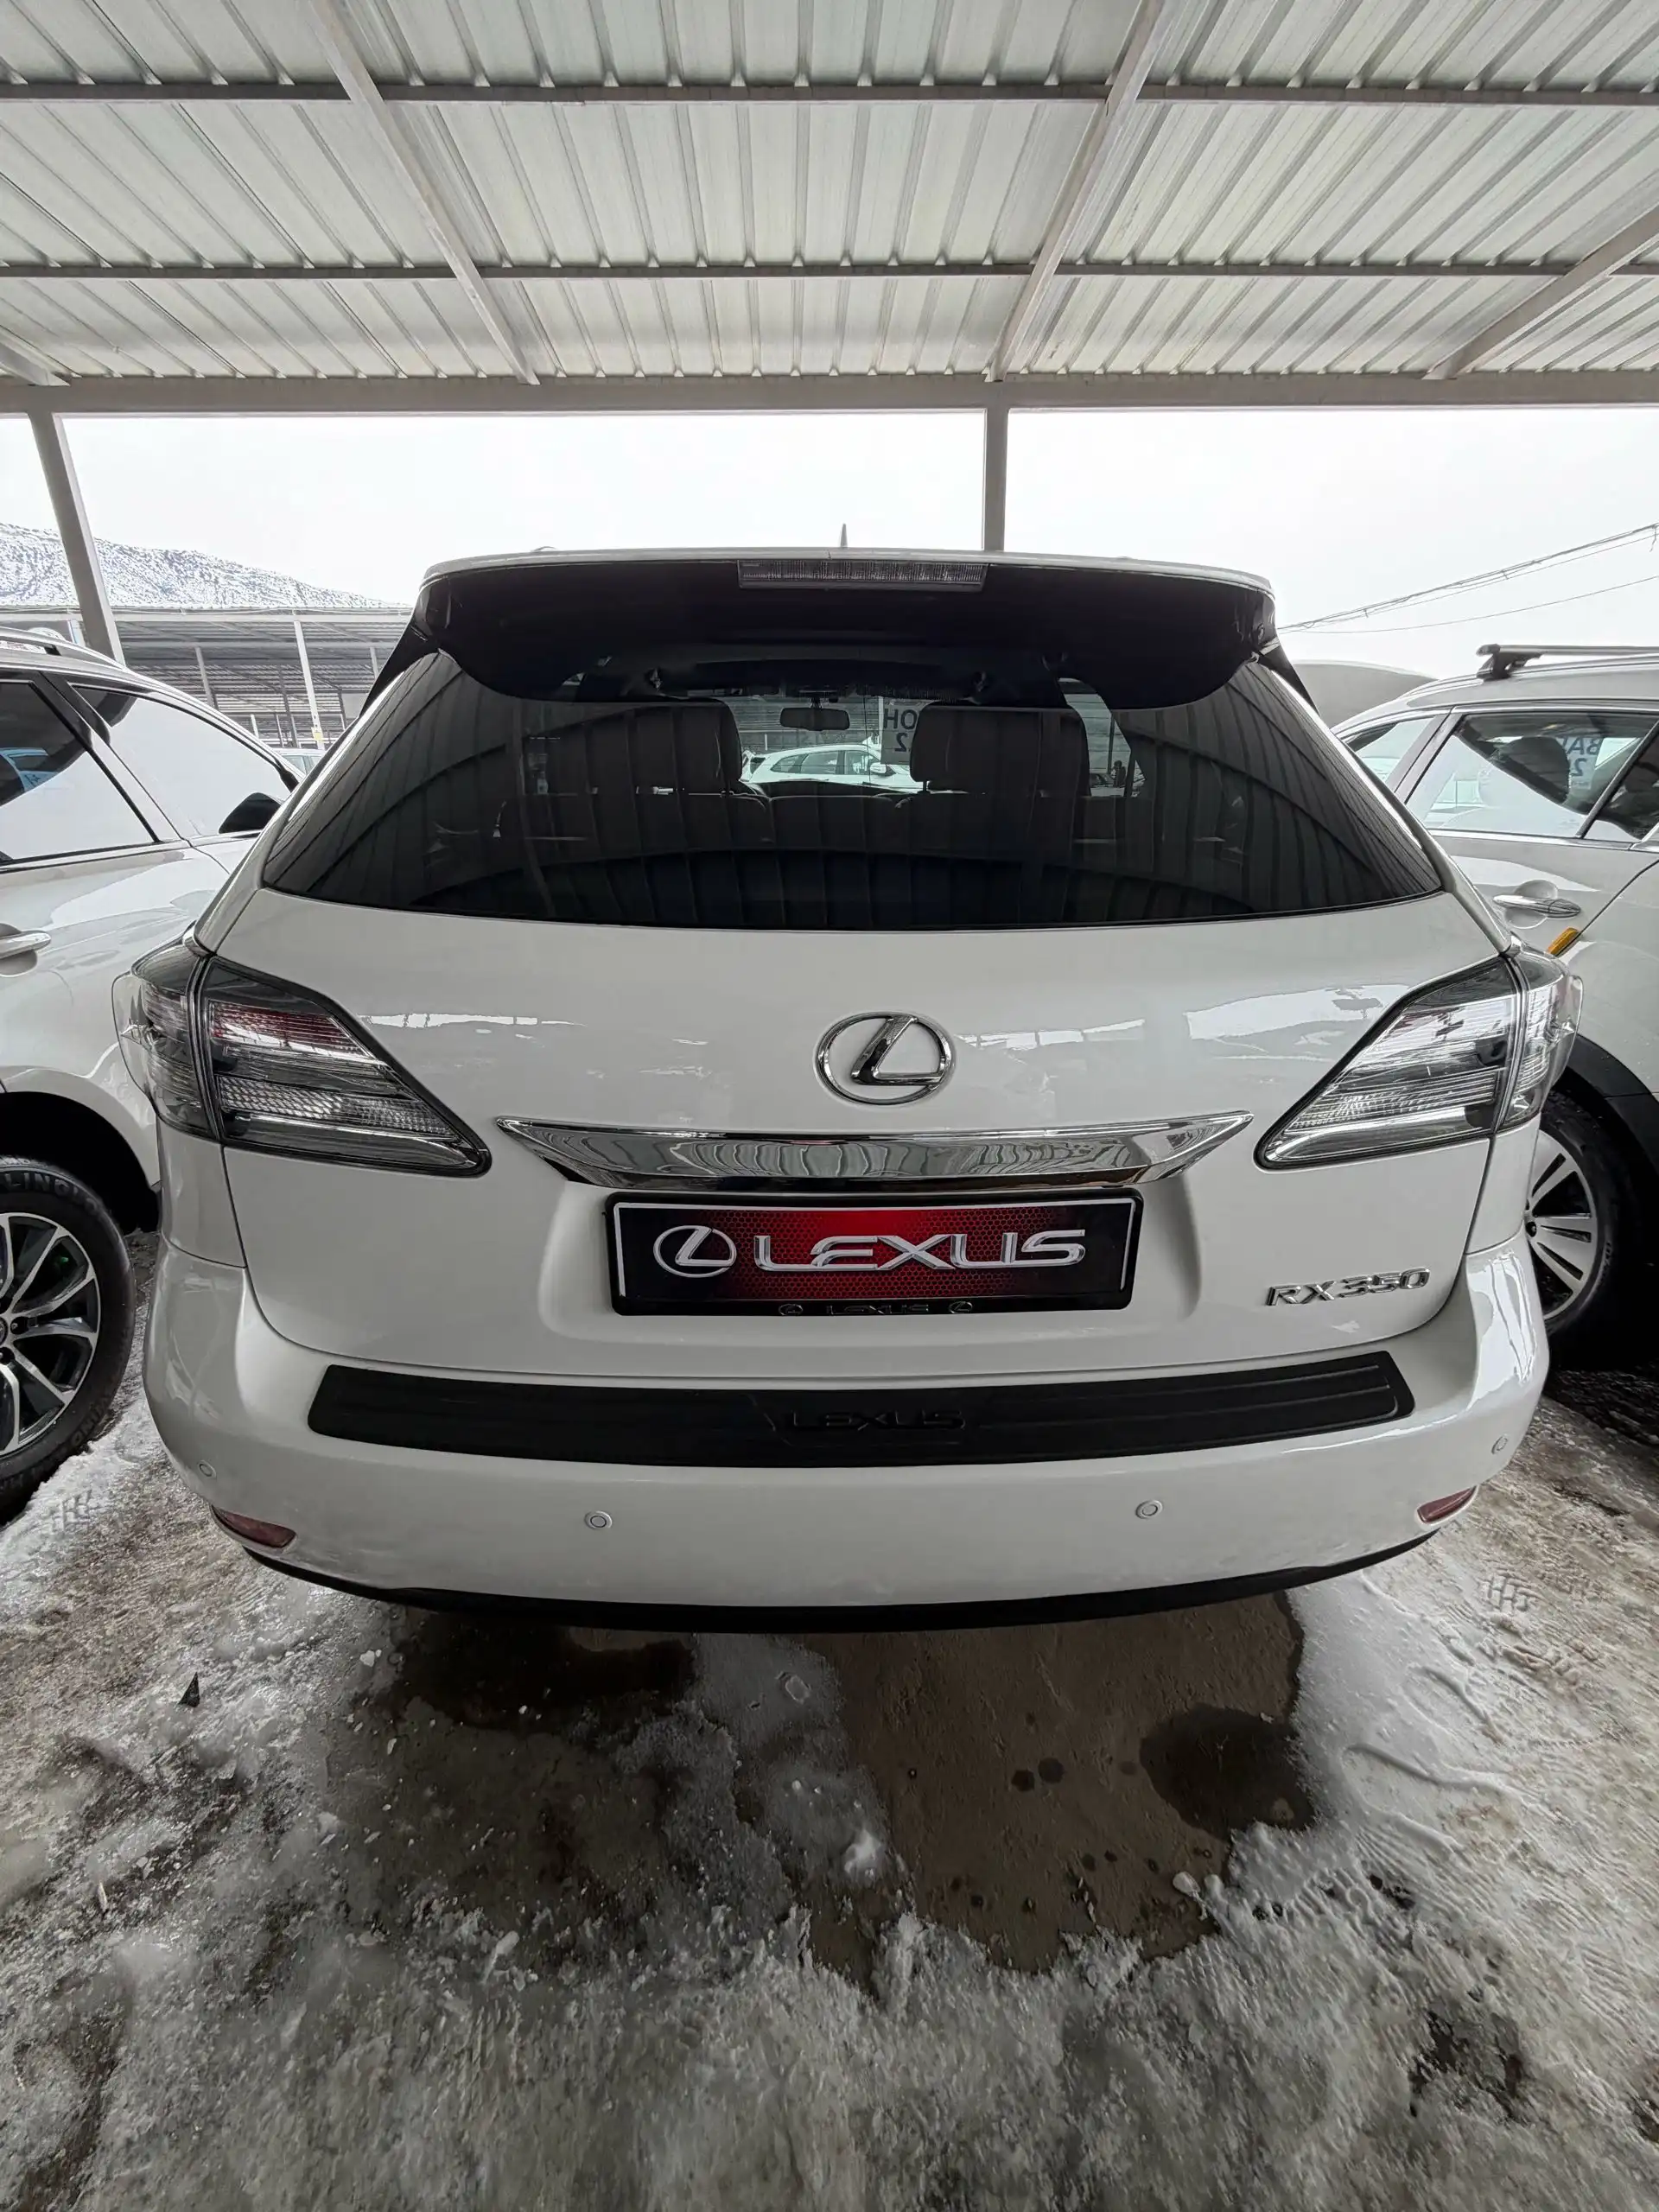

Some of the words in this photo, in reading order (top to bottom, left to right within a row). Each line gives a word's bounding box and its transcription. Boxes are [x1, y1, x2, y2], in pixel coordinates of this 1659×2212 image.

[753, 1230, 1086, 1272] LEXUS
[825, 1304, 930, 1316] LEXUS
[785, 1409, 967, 1431] LEXUS
